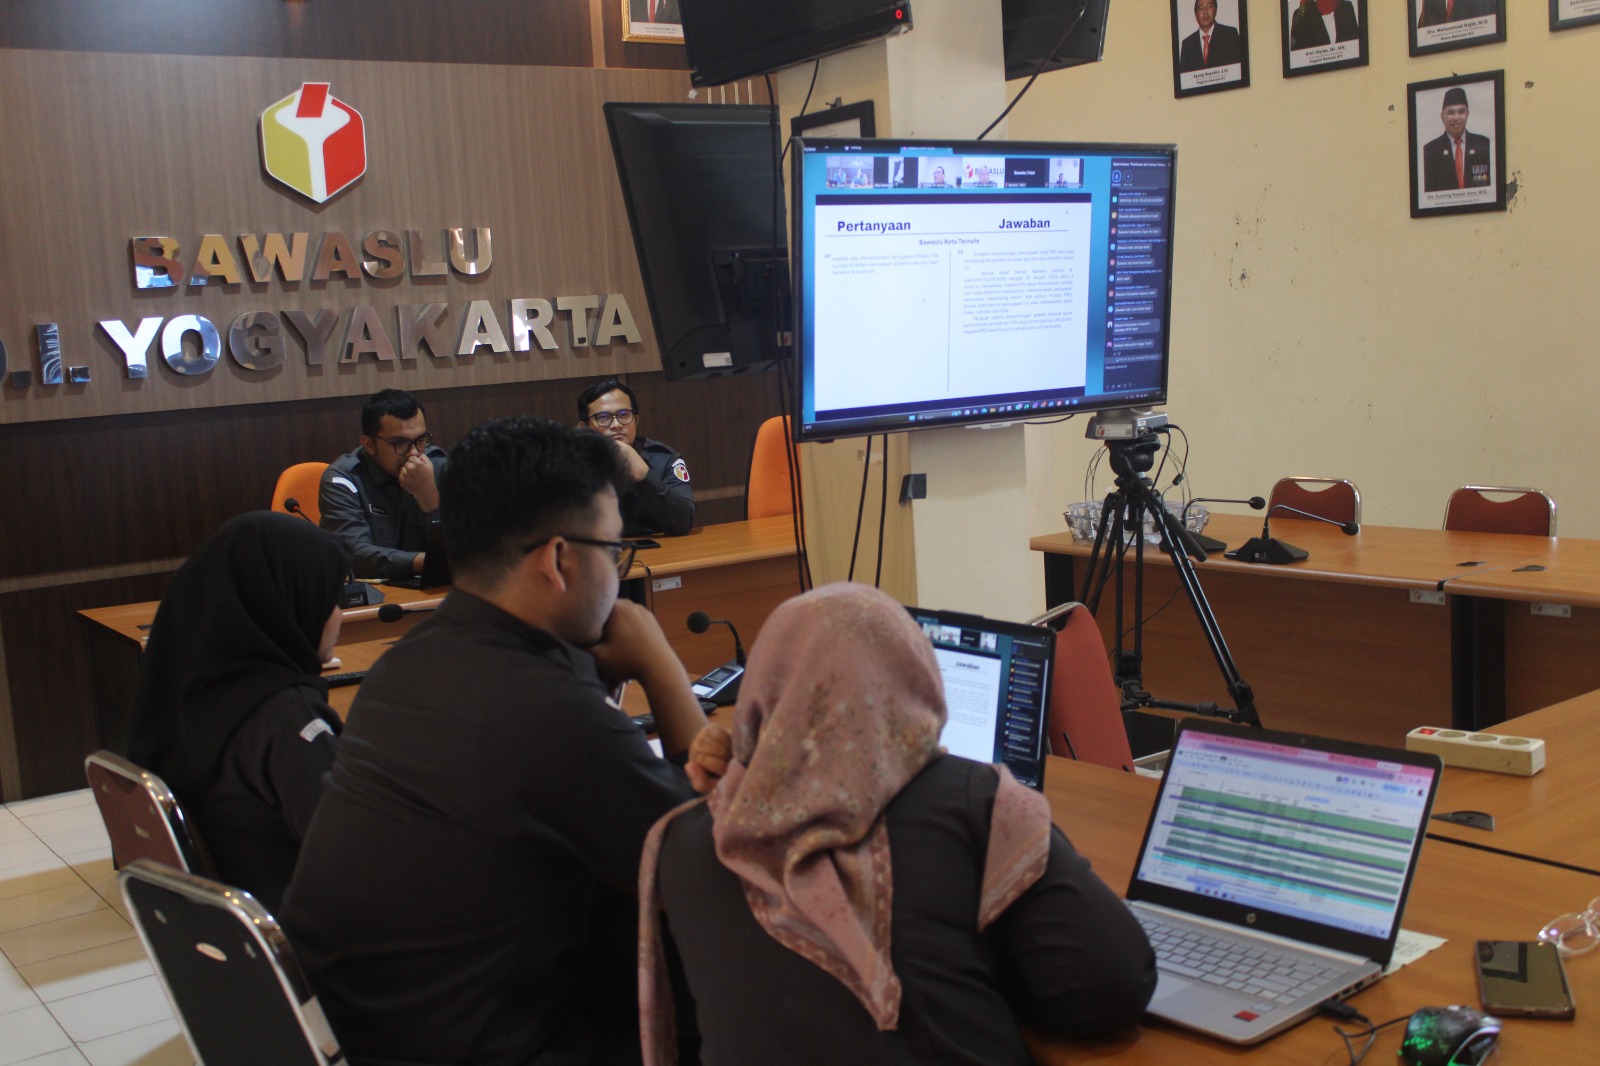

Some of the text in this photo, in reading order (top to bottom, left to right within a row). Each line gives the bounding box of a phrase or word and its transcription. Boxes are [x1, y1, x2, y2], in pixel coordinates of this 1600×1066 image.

[837, 220, 911, 234] Pertanyaan
[999, 218, 1051, 229] Jawaban
[131, 227, 493, 289] BAWASLU
[0, 293, 643, 386] .I. YOGYAKARTA
